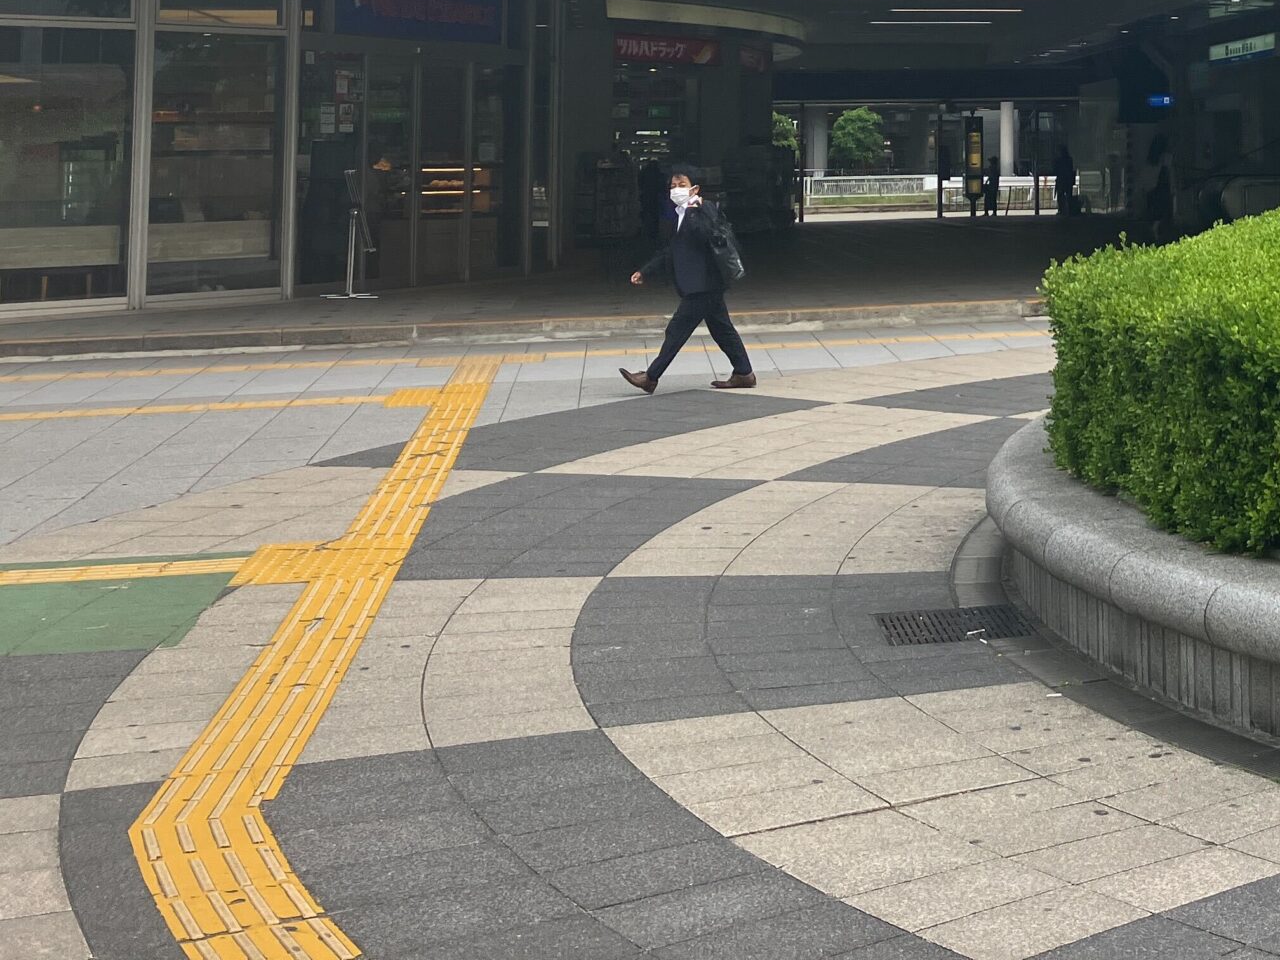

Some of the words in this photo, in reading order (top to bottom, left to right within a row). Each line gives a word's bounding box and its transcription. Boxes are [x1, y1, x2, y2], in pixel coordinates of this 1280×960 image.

[616, 38, 687, 59] ツルハドラッグ
